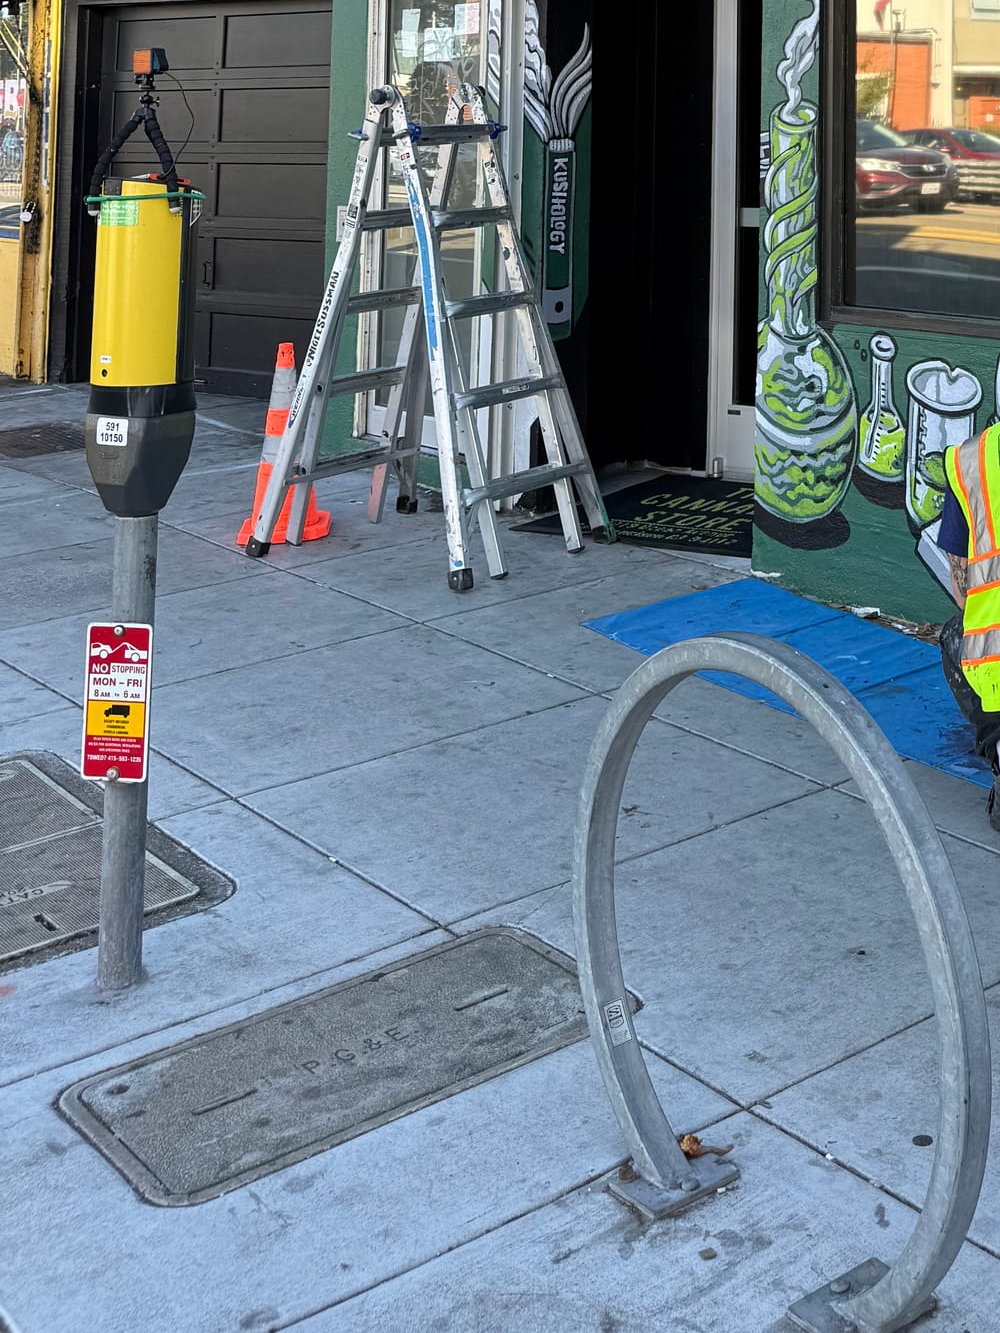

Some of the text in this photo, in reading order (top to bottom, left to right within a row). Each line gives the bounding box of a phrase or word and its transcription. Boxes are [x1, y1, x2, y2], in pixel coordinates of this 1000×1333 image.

[549, 157, 569, 255] KUSHOLOGY
[105, 421, 120, 432] 591
[99, 432, 124, 444] 10150
[639, 493, 754, 516] CANNA
[634, 510, 753, 531] STORE
[91, 663, 146, 675] NO STOPPING
[92, 677, 117, 687] MON
[126, 678, 143, 688] FRI
[93, 689, 99, 698] 8
